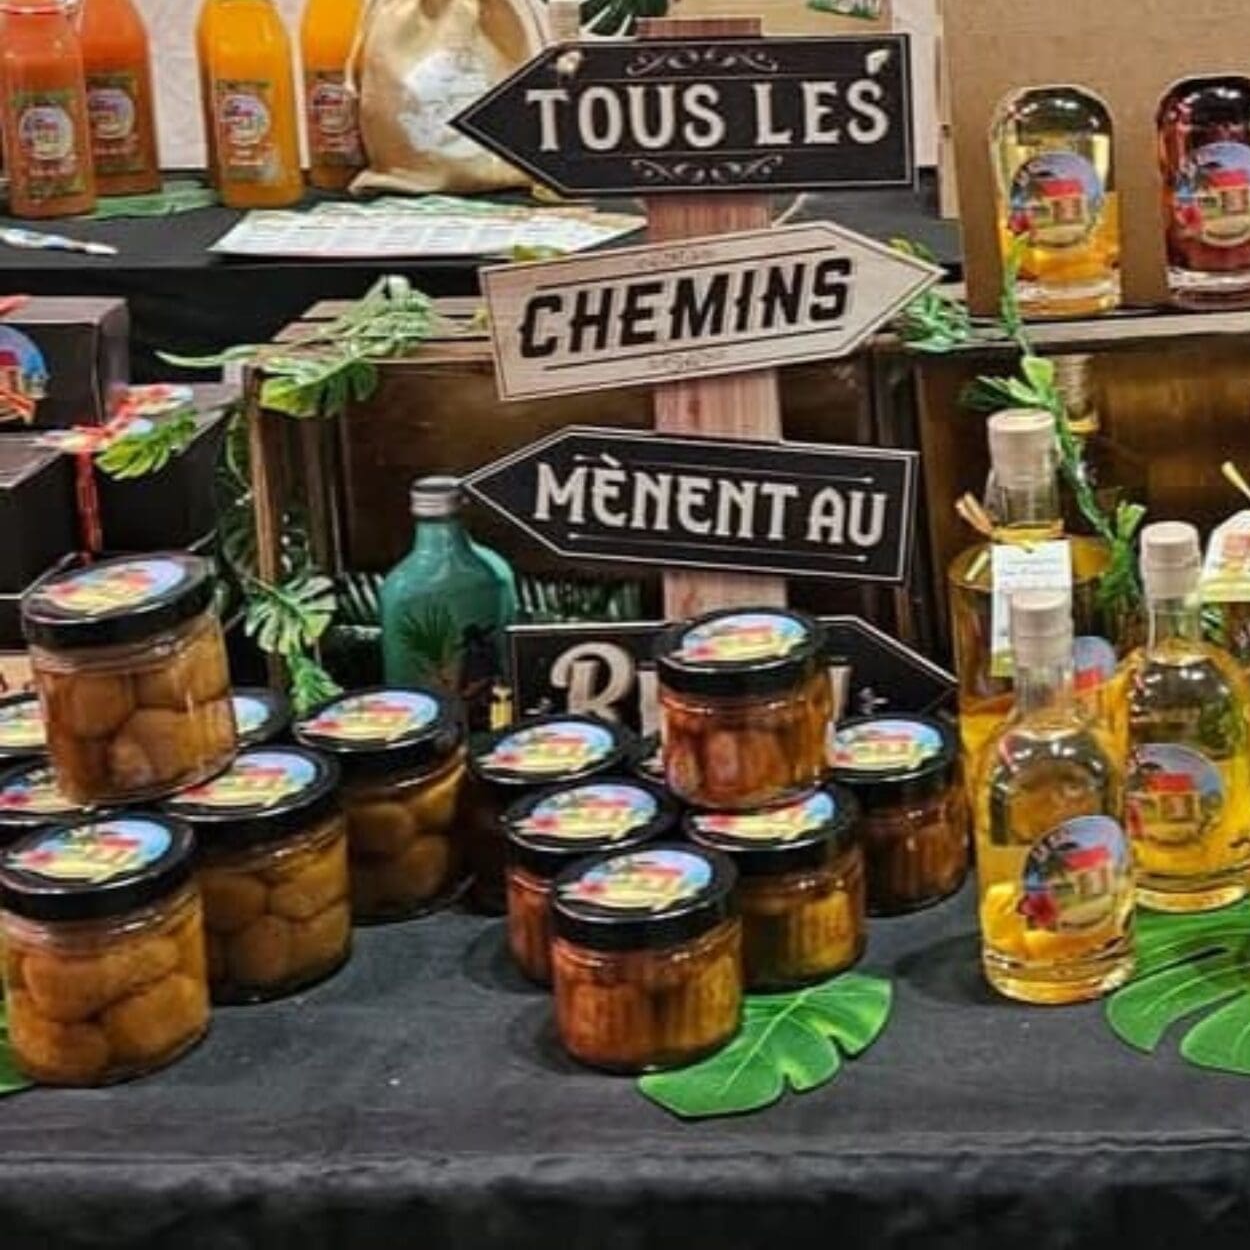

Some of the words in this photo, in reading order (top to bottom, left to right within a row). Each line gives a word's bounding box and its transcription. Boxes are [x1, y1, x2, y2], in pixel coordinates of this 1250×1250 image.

[525, 83, 726, 151] TOUS
[753, 78, 889, 145] LES
[517, 257, 853, 359] CHEMINS
[534, 453, 798, 540] MÈNENT
[806, 486, 888, 546] AU
